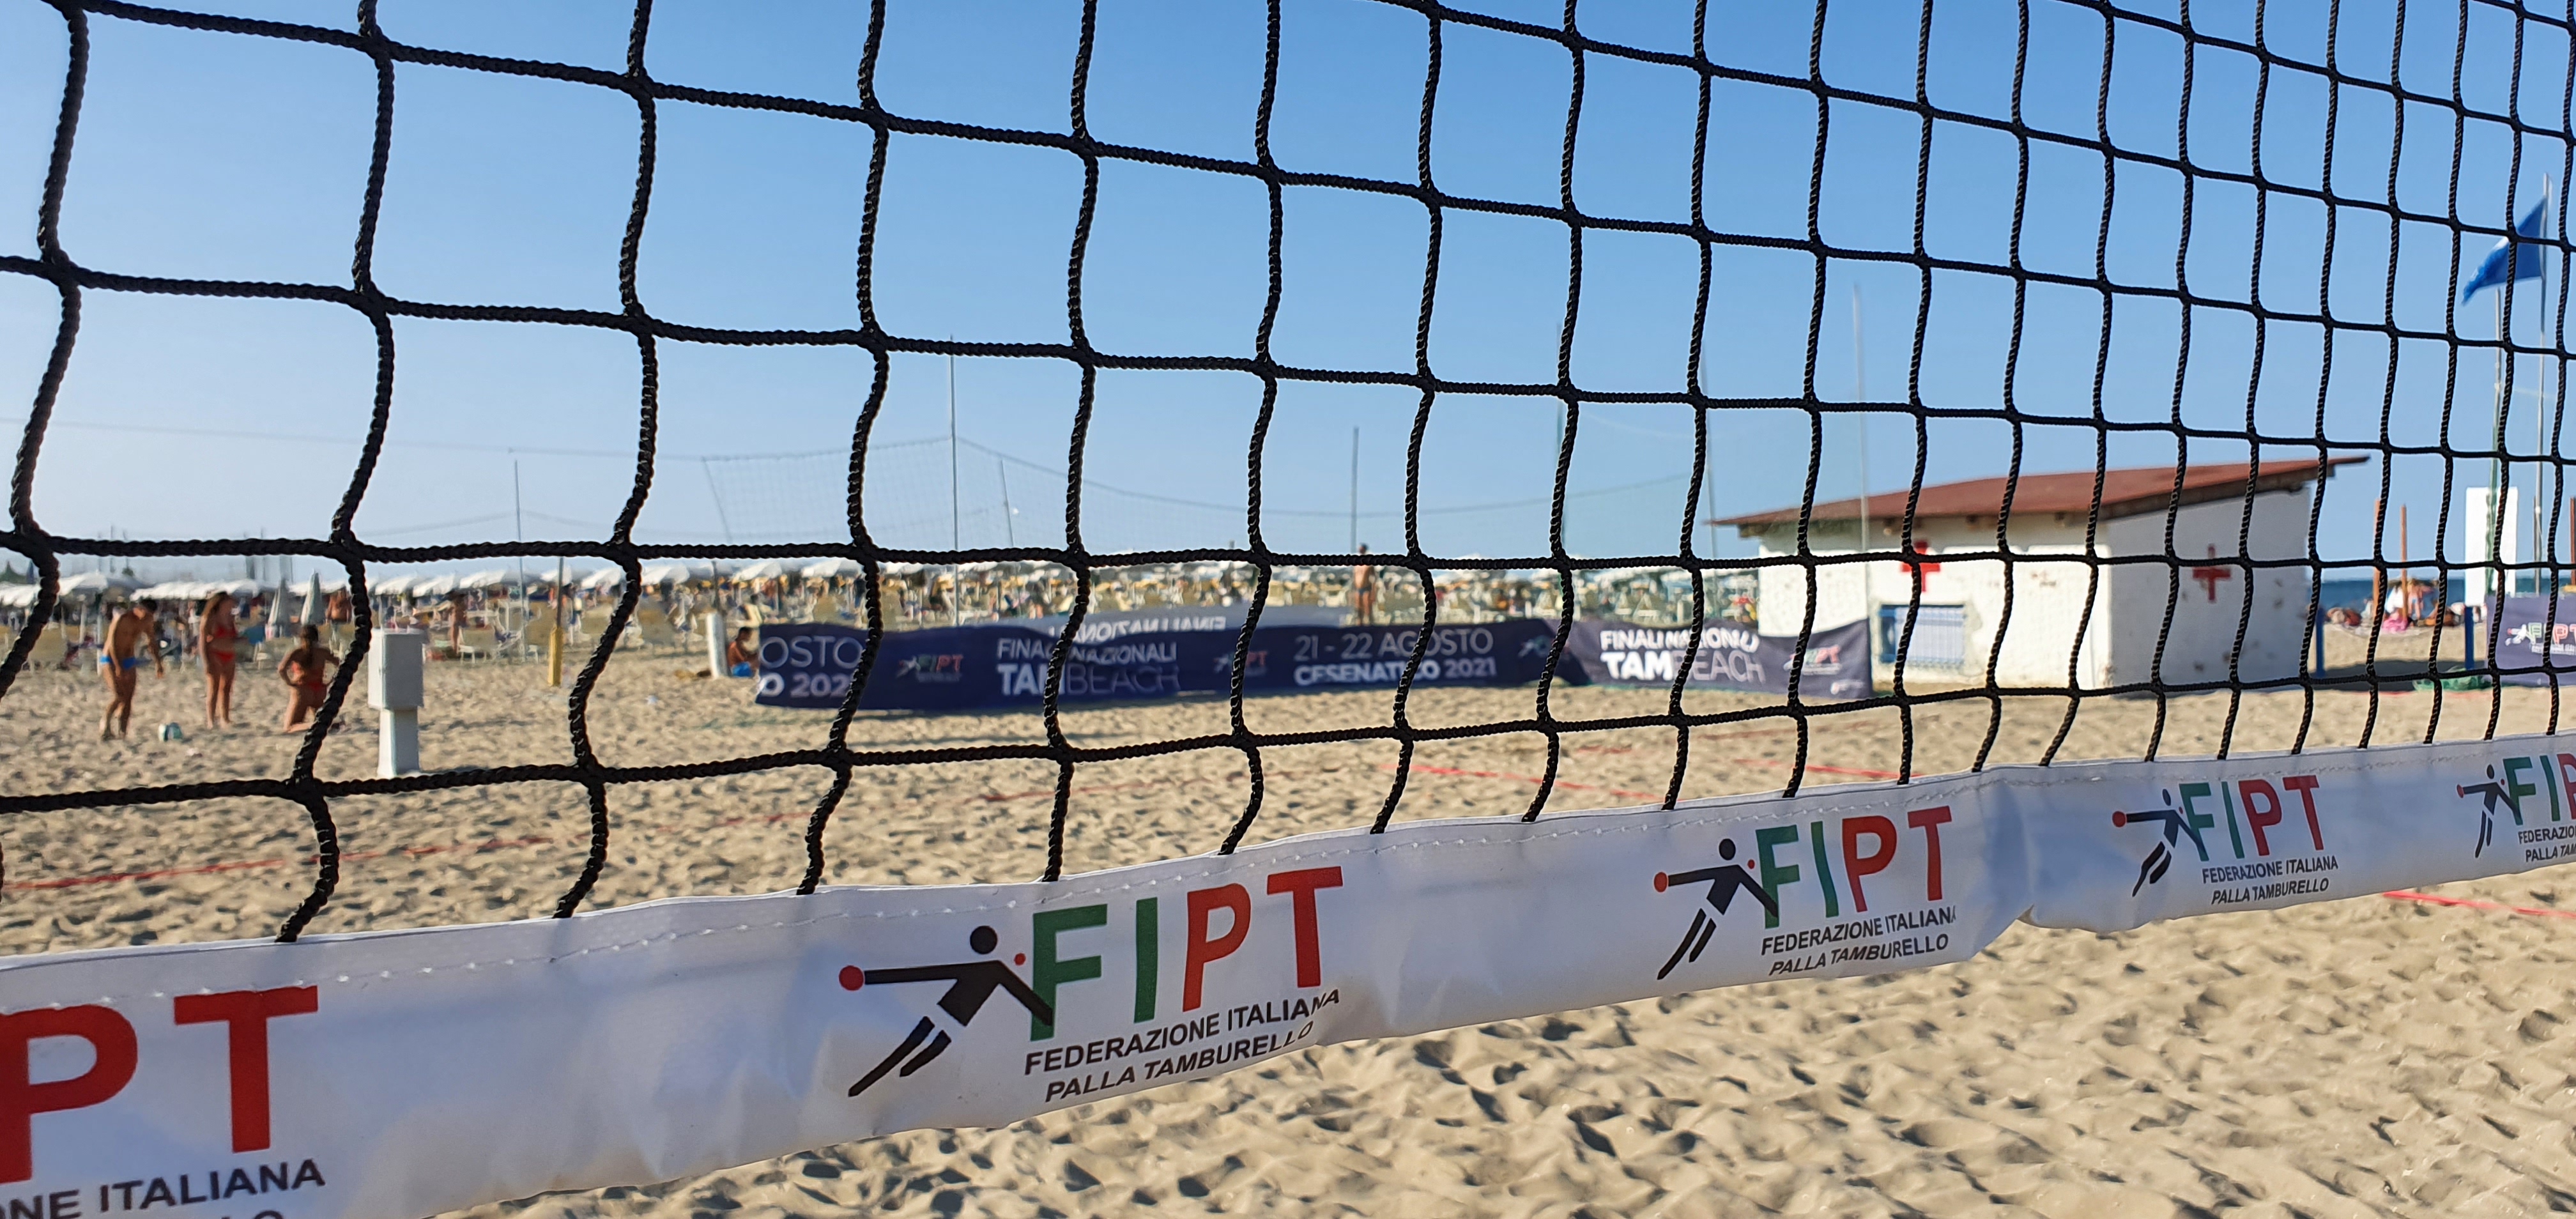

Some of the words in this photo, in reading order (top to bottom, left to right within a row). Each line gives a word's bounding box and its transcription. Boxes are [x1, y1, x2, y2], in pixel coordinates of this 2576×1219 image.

[997, 638, 1057, 659] FINAL
[1294, 635, 1319, 661] 21
[1341, 632, 1373, 659] 22
[1377, 627, 1494, 657] AGOSTO
[1600, 629, 1664, 650] FINALI
[2528, 622, 2576, 645] FP
[760, 636, 863, 669] OSTO
[790, 672, 852, 698] 202
[1294, 659, 1441, 686] CESENATIO
[1443, 656, 1497, 678] 2021
[2179, 774, 2324, 862] FIPT
[2518, 825, 2576, 845] FEDERAZIO
[1755, 805, 1952, 929] FIPT
[2202, 861, 2283, 884] FEDERAZIONE
[2286, 855, 2339, 874] ITALIANA
[2526, 845, 2558, 862] PALLA
[2211, 889, 2250, 905] PALLA
[2252, 877, 2329, 901] TAMBURELLO
[1761, 917, 1883, 956] FEDERAZIONE
[1030, 866, 1343, 1041] FIPT
[1768, 953, 1826, 976] PALLA
[1830, 933, 1949, 965] TAMBURELLO
[1024, 1013, 1220, 1076] FEDERAZIONE
[1227, 988, 1340, 1031] ITALIANA
[1045, 1065, 1135, 1103] PALLA
[1144, 1020, 1314, 1080] TAMBURELLO
[0, 1189, 82, 1219] NE
[100, 1158, 326, 1212] ITALIANA
